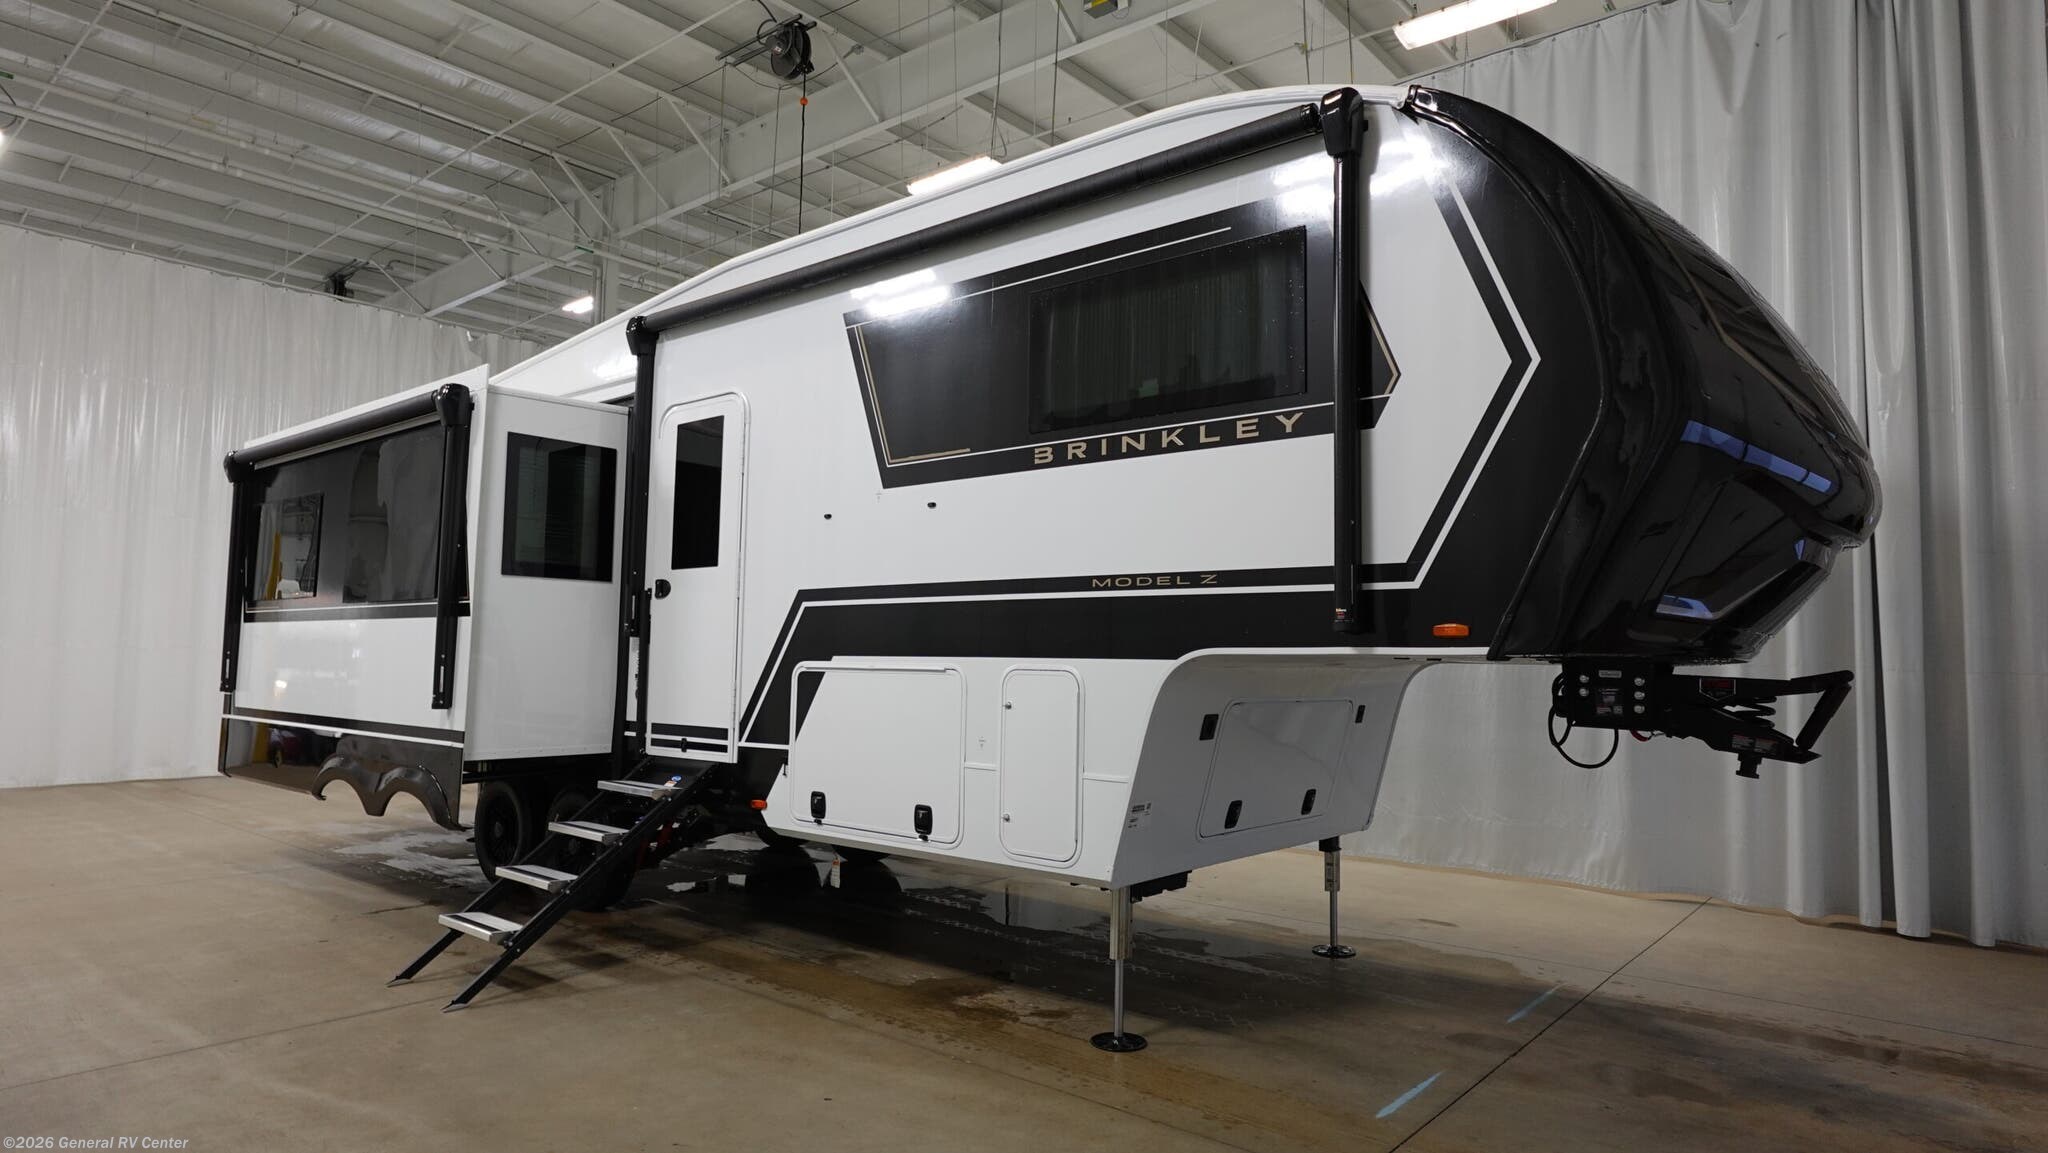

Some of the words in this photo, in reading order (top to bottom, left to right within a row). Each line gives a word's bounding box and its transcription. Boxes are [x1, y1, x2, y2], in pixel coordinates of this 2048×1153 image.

[1034, 411, 1304, 464] BRINKLEY
[1091, 575, 1191, 588] MODEL
[1199, 574, 1218, 585] Z
